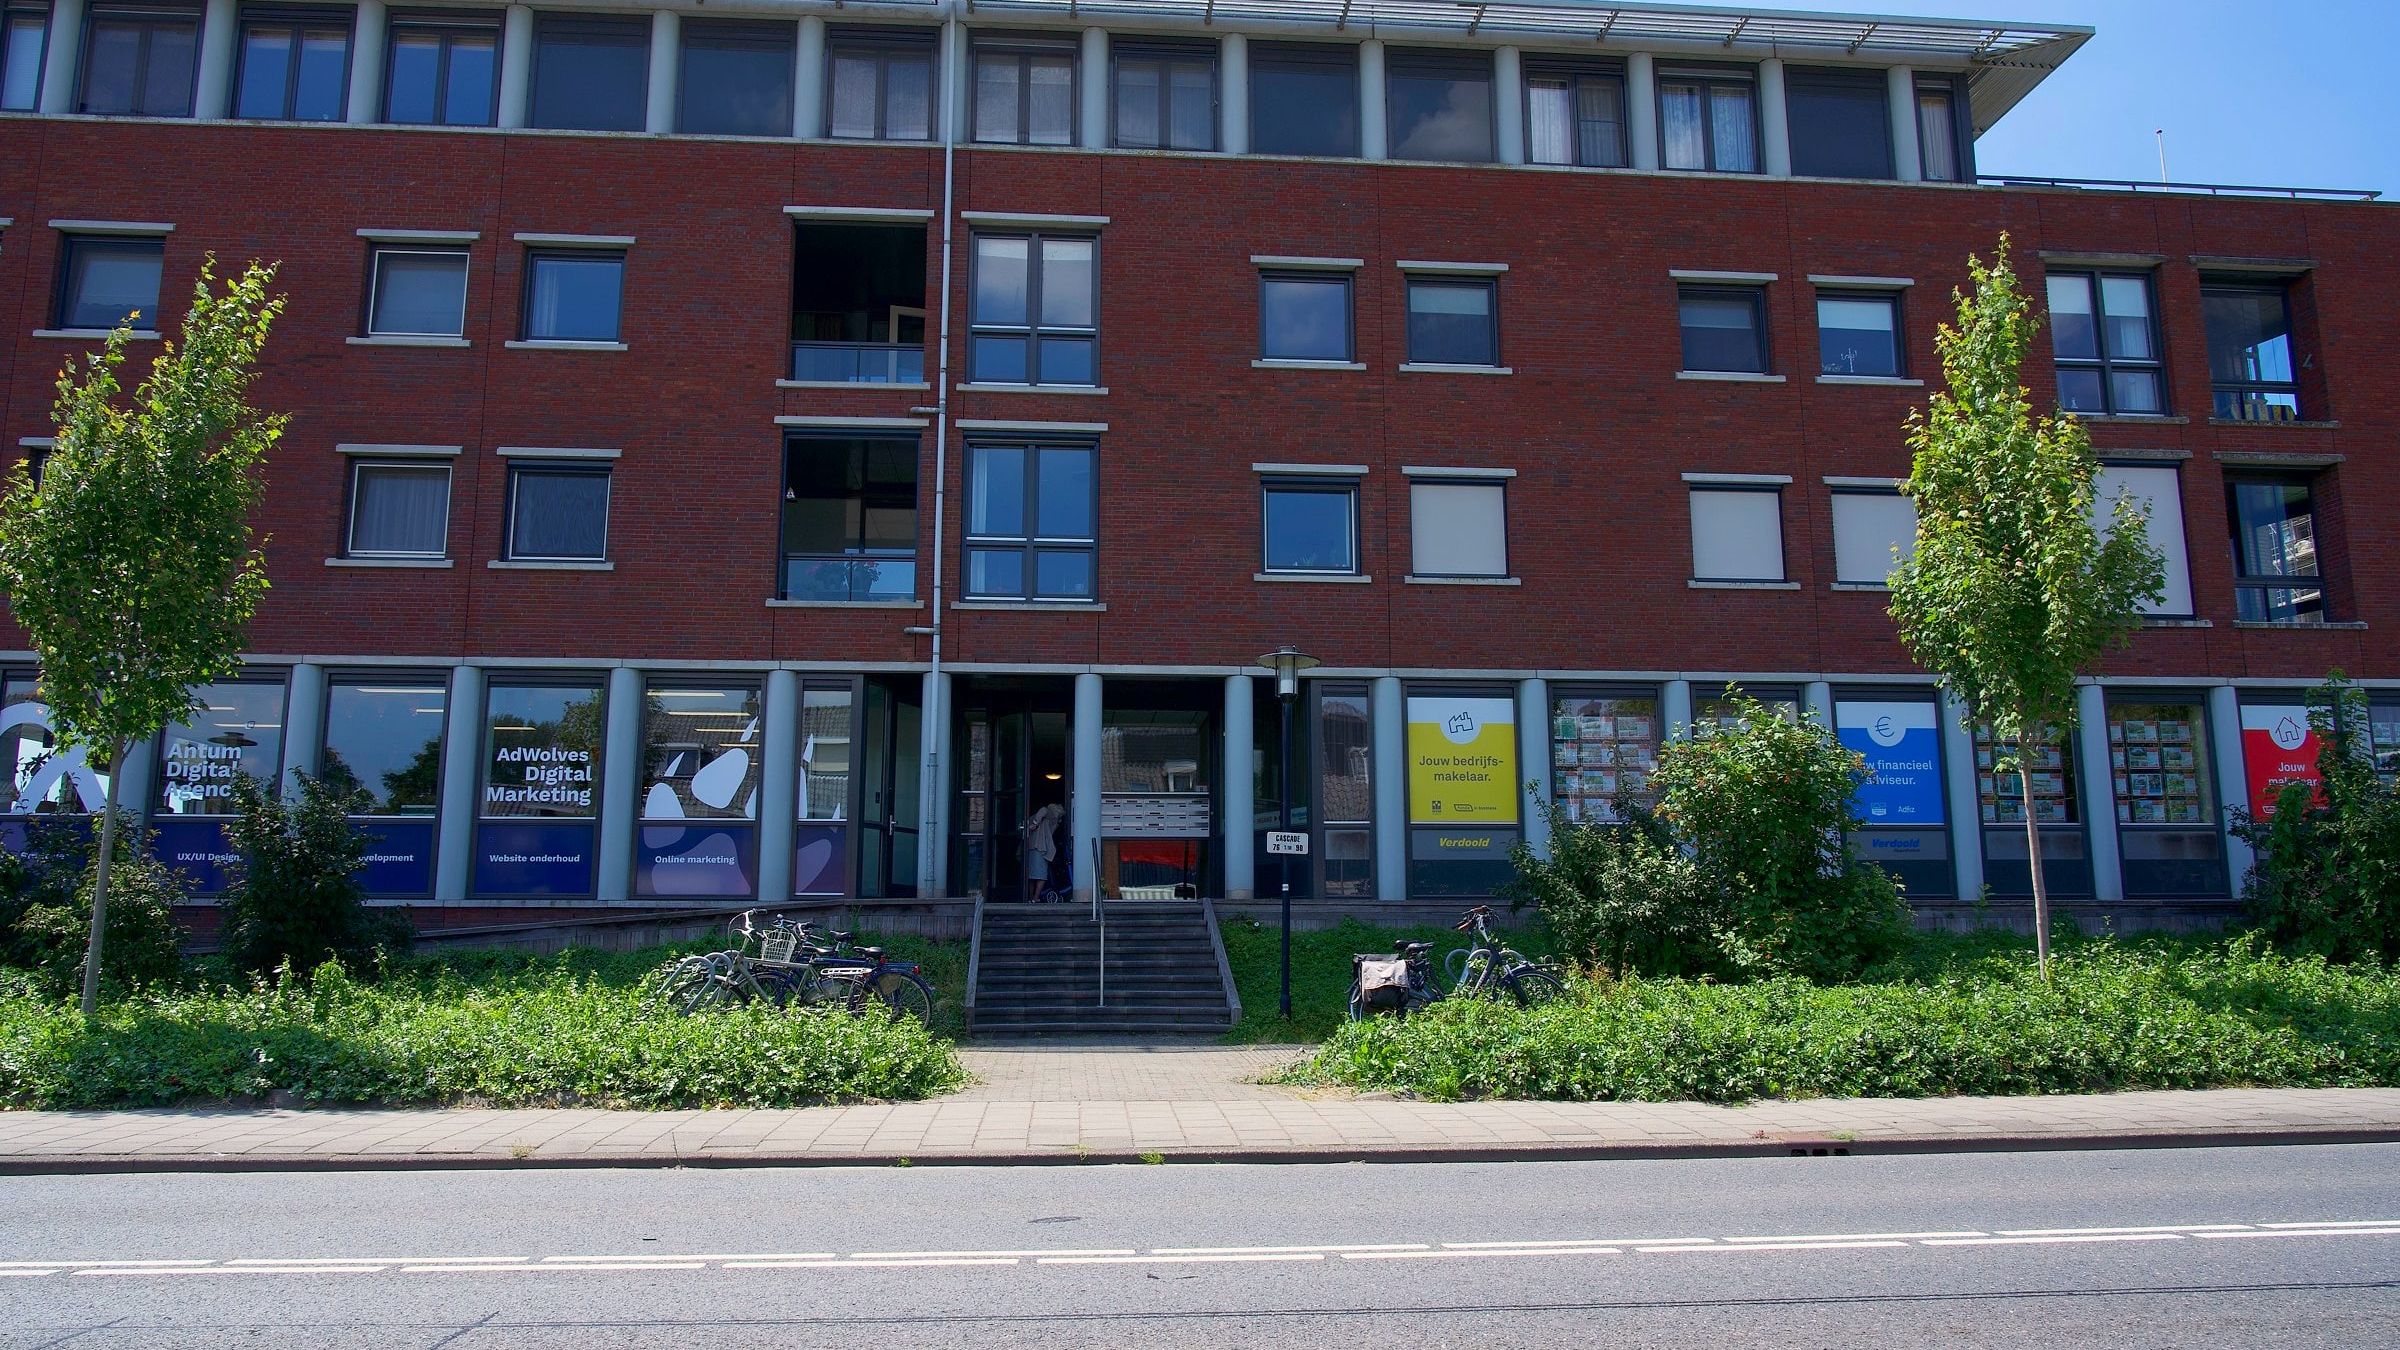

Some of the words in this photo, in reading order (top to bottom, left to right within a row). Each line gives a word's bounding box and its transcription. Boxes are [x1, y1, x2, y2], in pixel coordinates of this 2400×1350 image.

[167, 743, 242, 759] Antum
[496, 747, 589, 761] AdWolves
[1419, 756, 1450, 767] Jouw
[1453, 755, 1504, 769] bedrijfs-
[1877, 760, 1933, 770] financieel
[2278, 762, 2306, 772] Jouw
[166, 761, 238, 782] Digital
[525, 765, 593, 785] Digital
[1434, 771, 1491, 782] makelaar.
[163, 781, 232, 801] Agenc
[486, 786, 592, 806] Marketing
[1275, 834, 1301, 843] CASCADE
[1440, 837, 1490, 848] Verdoold
[1872, 838, 1921, 848] Verdoold
[177, 852, 206, 861] UX/UI
[208, 852, 240, 863] Design
[358, 853, 414, 863] velopment
[489, 854, 528, 863] Website
[529, 854, 580, 863] onderhoud
[655, 855, 685, 864] Online
[687, 855, 735, 866] marketing
